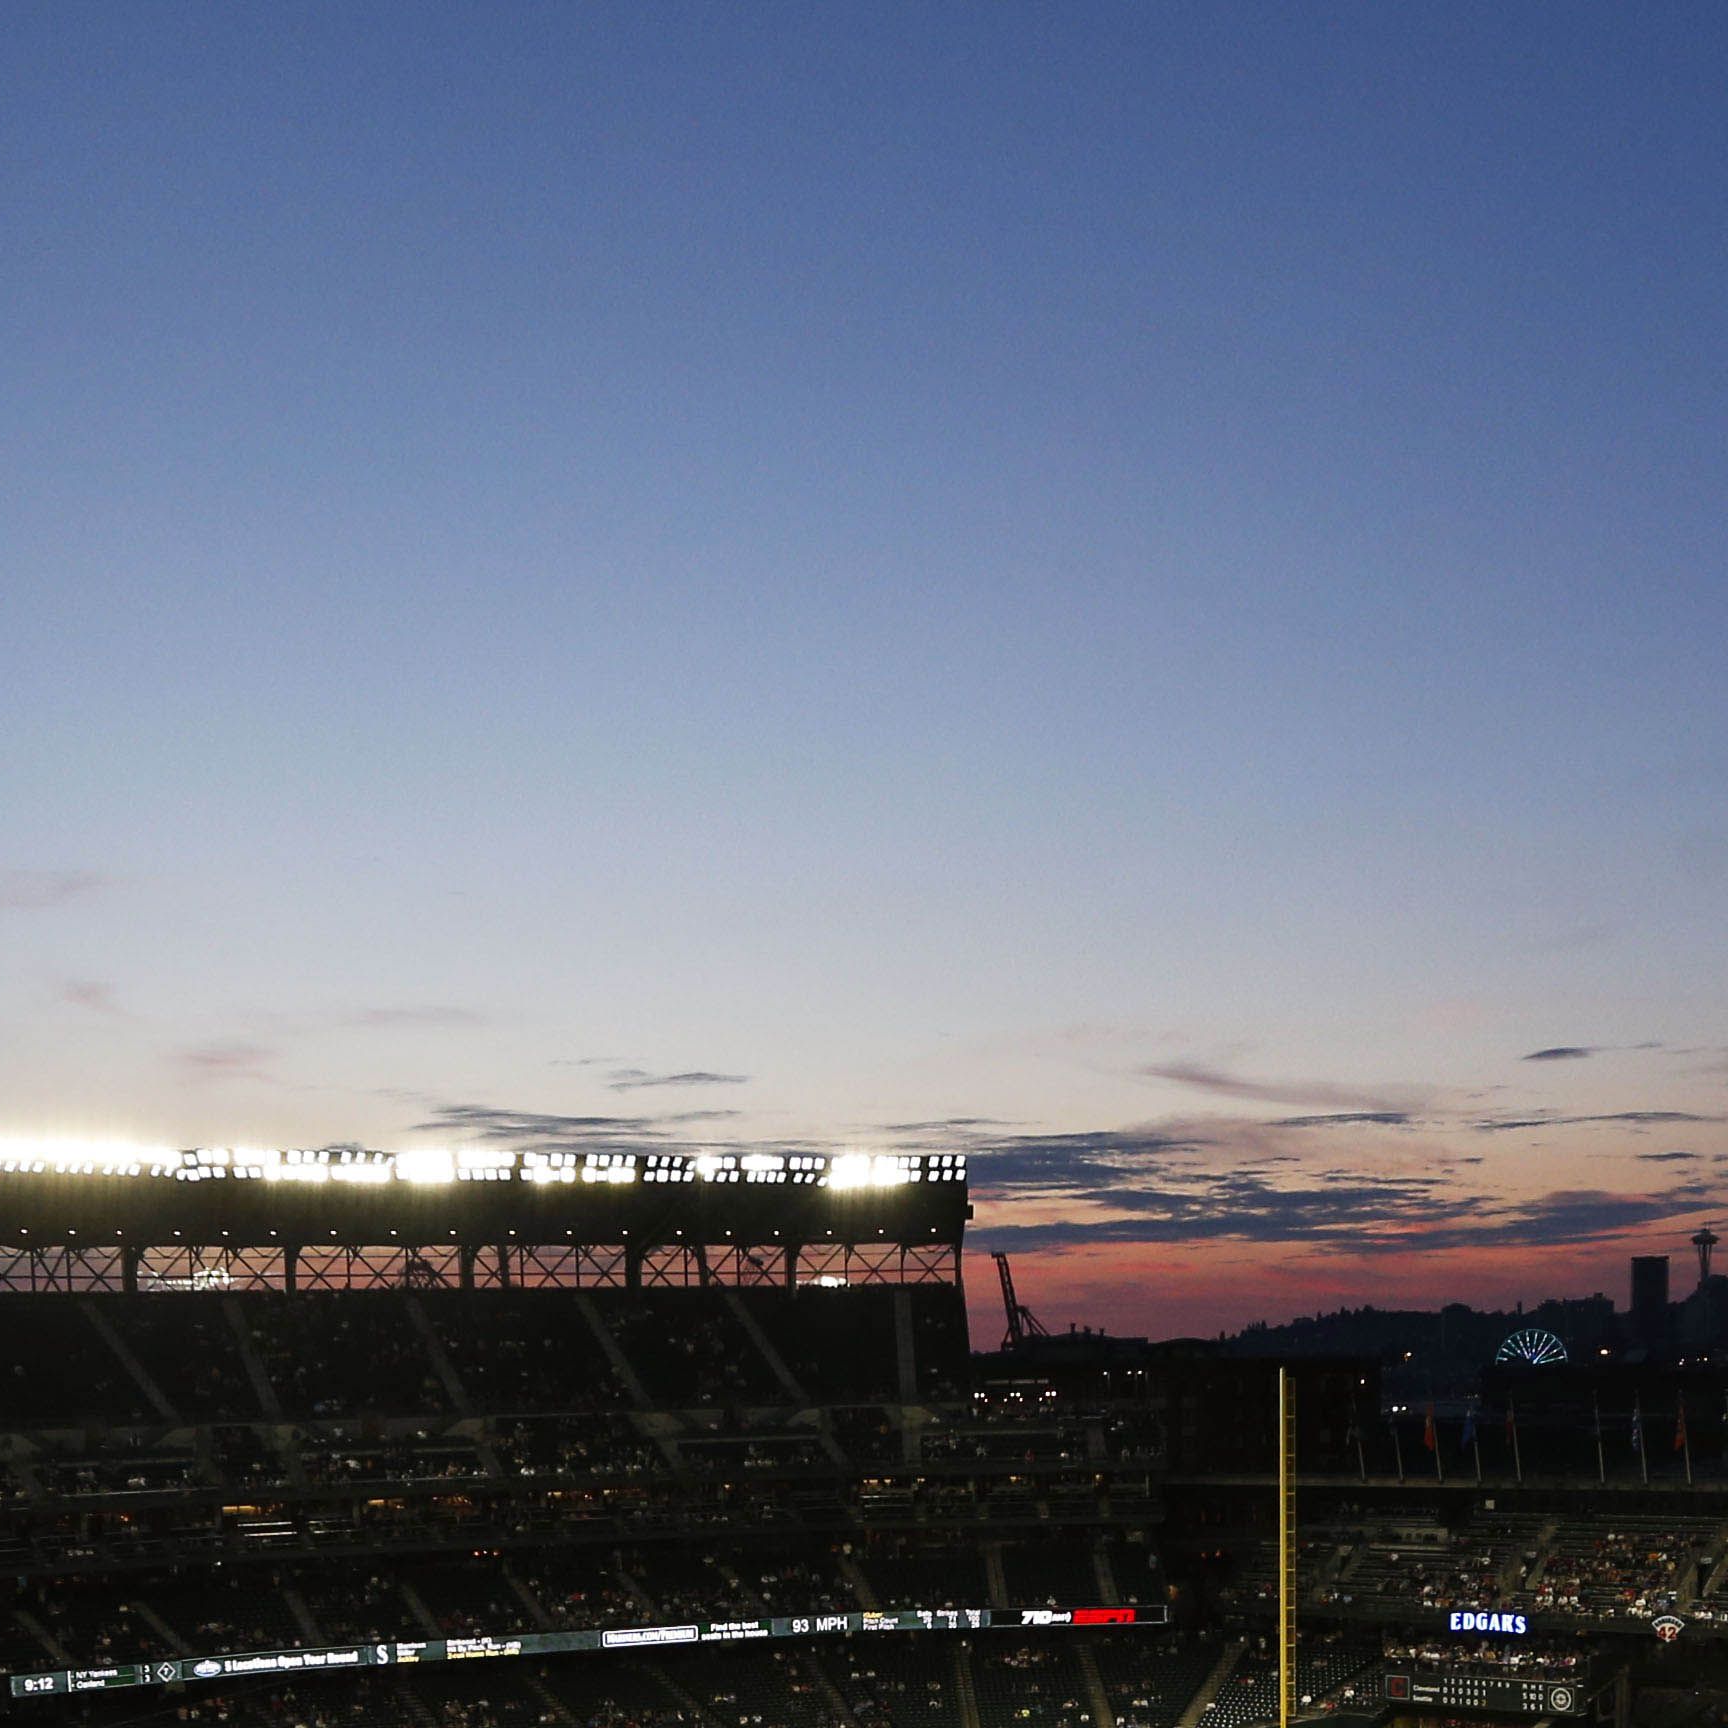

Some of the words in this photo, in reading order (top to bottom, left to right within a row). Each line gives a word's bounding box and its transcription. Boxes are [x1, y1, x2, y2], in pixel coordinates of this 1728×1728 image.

[792, 1618, 809, 1633] 93
[816, 1616, 848, 1632] MPH
[24, 1677, 54, 1691] 9:12
